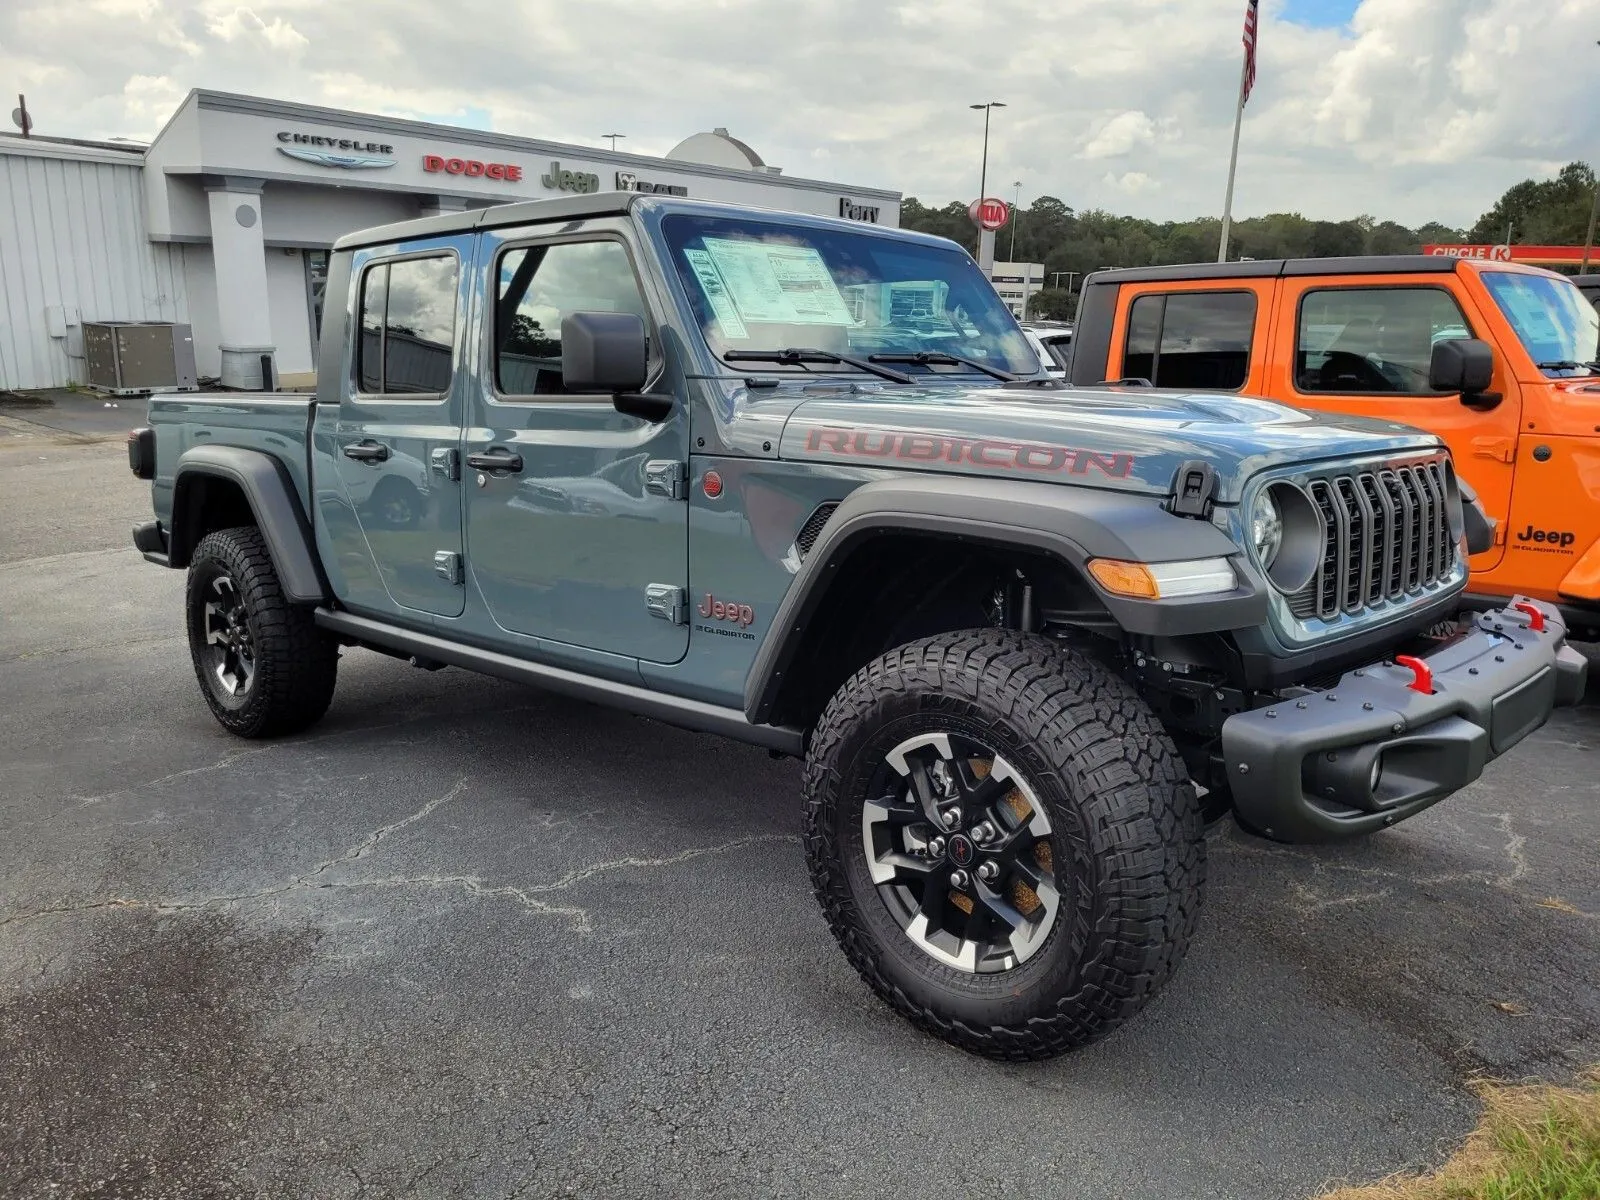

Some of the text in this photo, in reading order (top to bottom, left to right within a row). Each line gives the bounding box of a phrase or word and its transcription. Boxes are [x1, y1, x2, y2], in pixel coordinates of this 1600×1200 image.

[277, 132, 394, 154] CHRYSLER
[423, 154, 523, 182] DODGE
[541, 161, 600, 194] Jeep
[637, 181, 688, 198] RAM
[839, 197, 880, 224] Perry
[980, 204, 1002, 223] KIA
[1432, 247, 1486, 260] CIRCLE
[805, 427, 1136, 479] RUBICON
[1517, 525, 1575, 548] Jeep
[697, 592, 754, 629] Jeep
[703, 625, 756, 641] GLADIATOR
